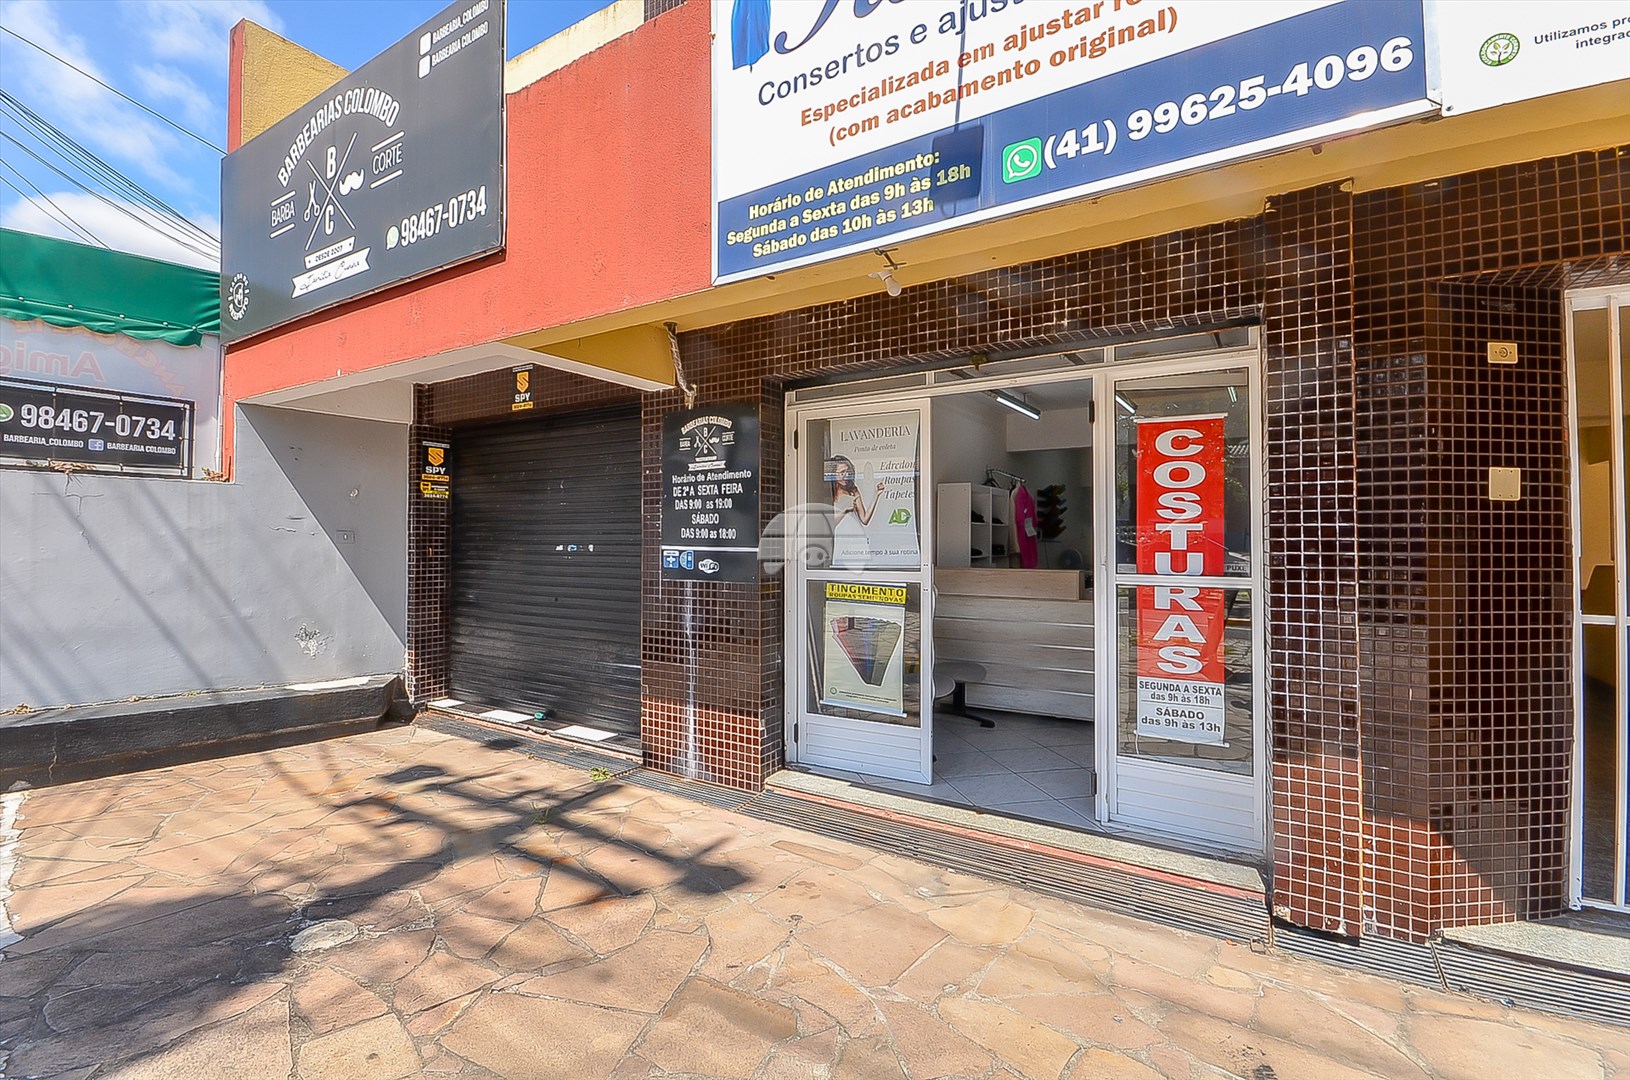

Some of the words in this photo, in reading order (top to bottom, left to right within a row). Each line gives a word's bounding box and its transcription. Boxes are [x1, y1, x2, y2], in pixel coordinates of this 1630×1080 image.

[461, 21, 489, 48] COLOMBO
[1534, 21, 1608, 45] Utilizamos
[758, 34, 900, 106] Consertos
[910, 23, 928, 44] e
[938, 0, 1024, 36] ajus
[801, 59, 950, 127] Especializada
[957, 42, 995, 68] em
[1003, 2, 1104, 51] ajustar
[829, 115, 880, 147] (com
[886, 59, 1041, 124] acabamento
[1050, 6, 1178, 67] original)
[1044, 119, 1118, 169] (41)
[1127, 36, 1414, 142] 99625-4096
[278, 95, 343, 187] BARBEARIAS
[344, 88, 400, 127] COLOMBO
[326, 146, 336, 179] B
[372, 142, 403, 175] CORTE
[749, 192, 801, 220] Horário
[804, 186, 824, 203] de
[827, 151, 940, 196] Atendimento:
[271, 200, 295, 226] BARBA
[401, 185, 487, 247] 98467-0734
[726, 216, 787, 246] Segunda
[789, 212, 800, 227] a
[802, 200, 846, 224] Sexta
[850, 191, 880, 210] das
[884, 182, 906, 201] 9h
[910, 176, 931, 194] às
[936, 164, 971, 186] 18h
[325, 204, 334, 235] C
[752, 231, 807, 258] Sábado
[810, 224, 838, 242] das
[842, 214, 872, 235] 10h
[876, 207, 896, 226] às
[901, 196, 934, 219] 13h
[515, 392, 530, 402] SPY
[21, 404, 176, 441] 98467-0734
[841, 426, 911, 442] LAVANDERIA
[3, 434, 84, 449] BARBEARIA_COLOMBO
[107, 442, 144, 452] BARBEARIA
[145, 445, 176, 455] COLOMBO
[425, 466, 446, 474] SPY
[672, 474, 696, 483] Horário
[697, 473, 705, 481] de
[706, 470, 751, 481] Atendimento
[673, 486, 682, 497] DE
[698, 484, 719, 495] SEXTA
[721, 483, 743, 494] FEIRA
[675, 499, 688, 510] DAS
[706, 501, 713, 509] as
[691, 512, 720, 524] SÁBADO
[681, 528, 695, 539] DAS
[709, 530, 717, 539] as
[829, 584, 904, 597] TINGIMENTO
[1139, 681, 1180, 692] SEGUNDA
[1184, 685, 1190, 693] A
[1192, 686, 1222, 696] SEXTA
[1151, 692, 1165, 701] das
[1168, 693, 1178, 702] 9h
[1181, 694, 1191, 703] às
[1194, 695, 1210, 704] 18h
[1141, 716, 1161, 725] das
[1165, 718, 1178, 728] 9h
[1182, 720, 1195, 729] às
[1199, 722, 1221, 732] 13h
[1156, 707, 1204, 720] SÁBADO
